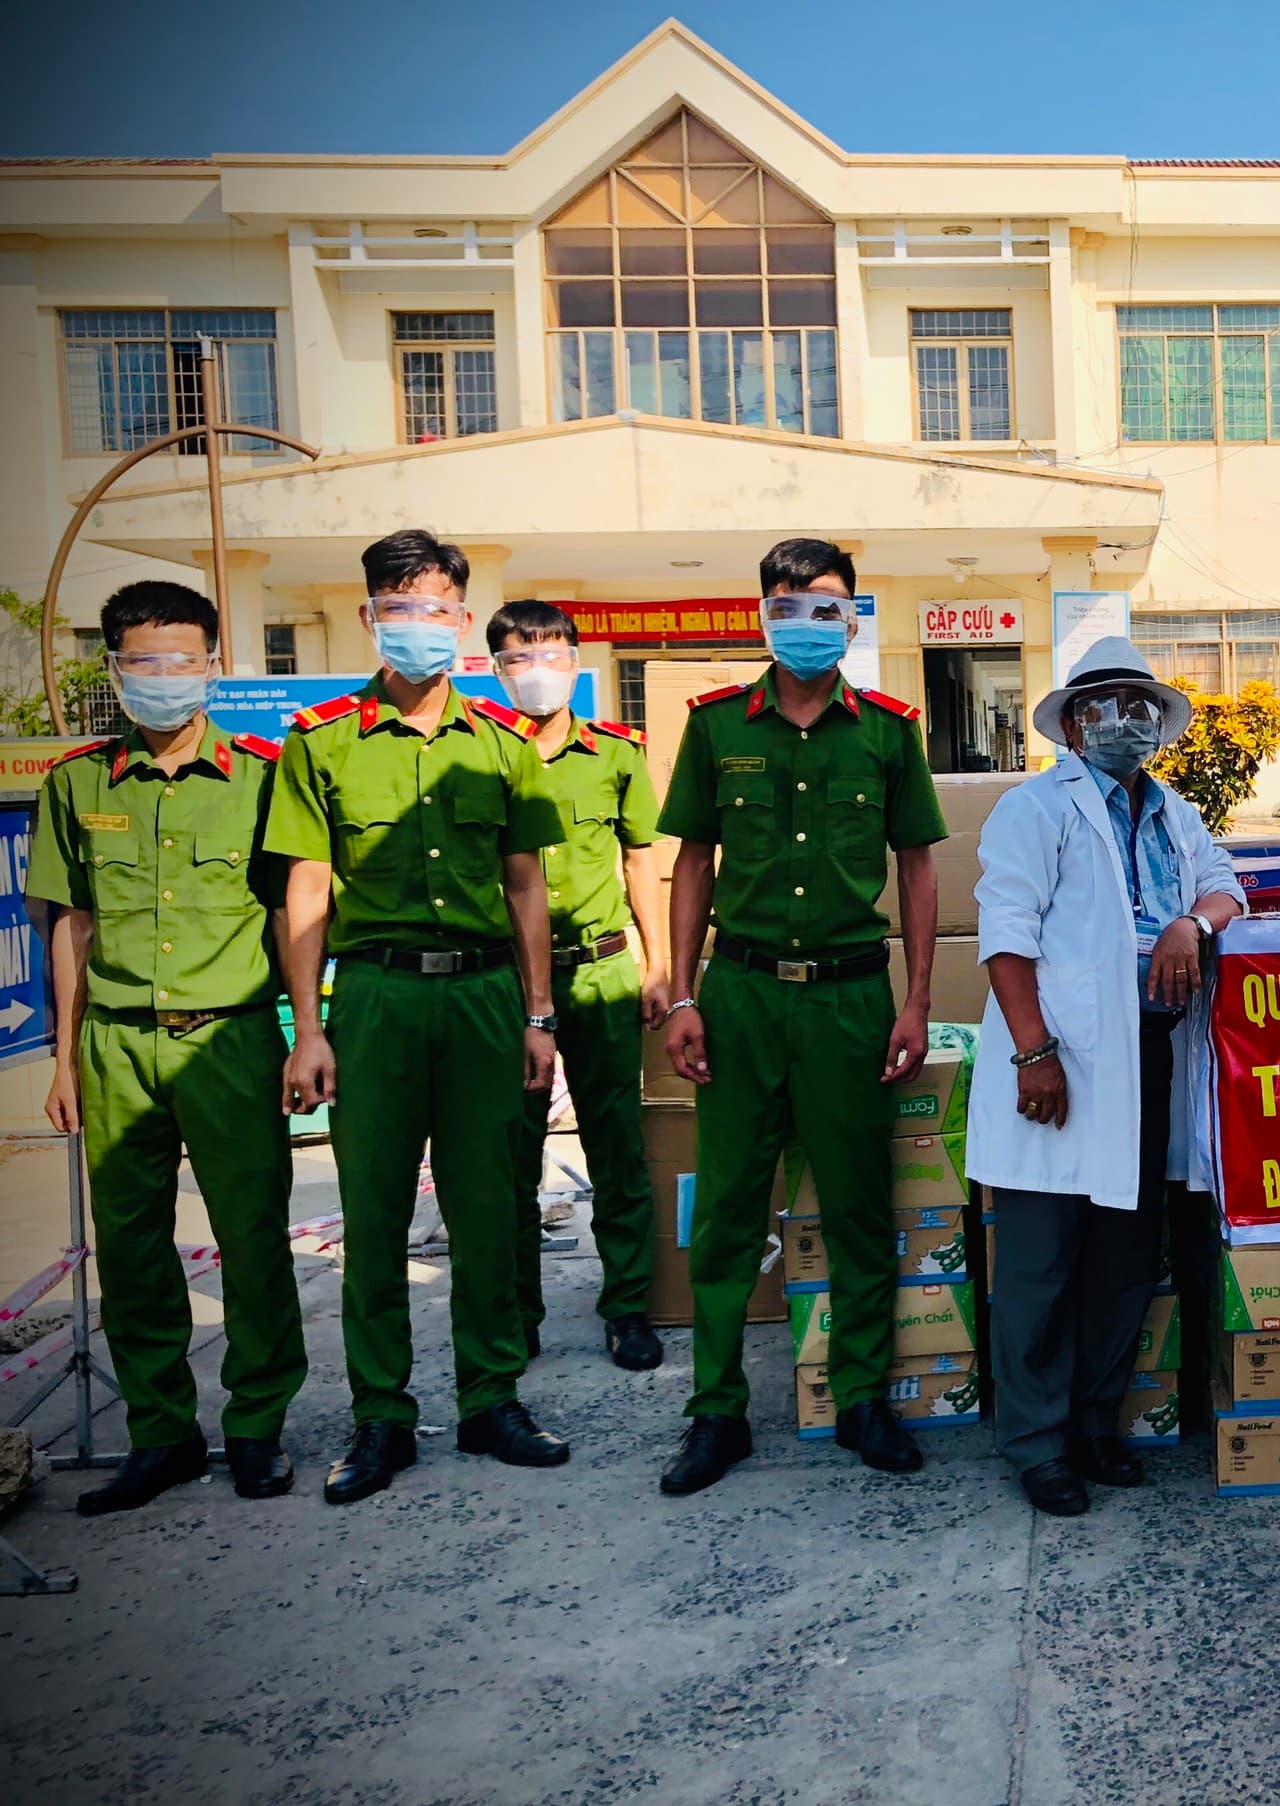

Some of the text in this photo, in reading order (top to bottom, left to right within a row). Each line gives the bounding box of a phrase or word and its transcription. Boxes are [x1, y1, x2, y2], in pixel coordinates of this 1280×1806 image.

[926, 604, 958, 632] CẤP
[927, 631, 994, 640] FIRST AID
[12, 759, 49, 775] COV
[924, 1307, 954, 1325] Chất
